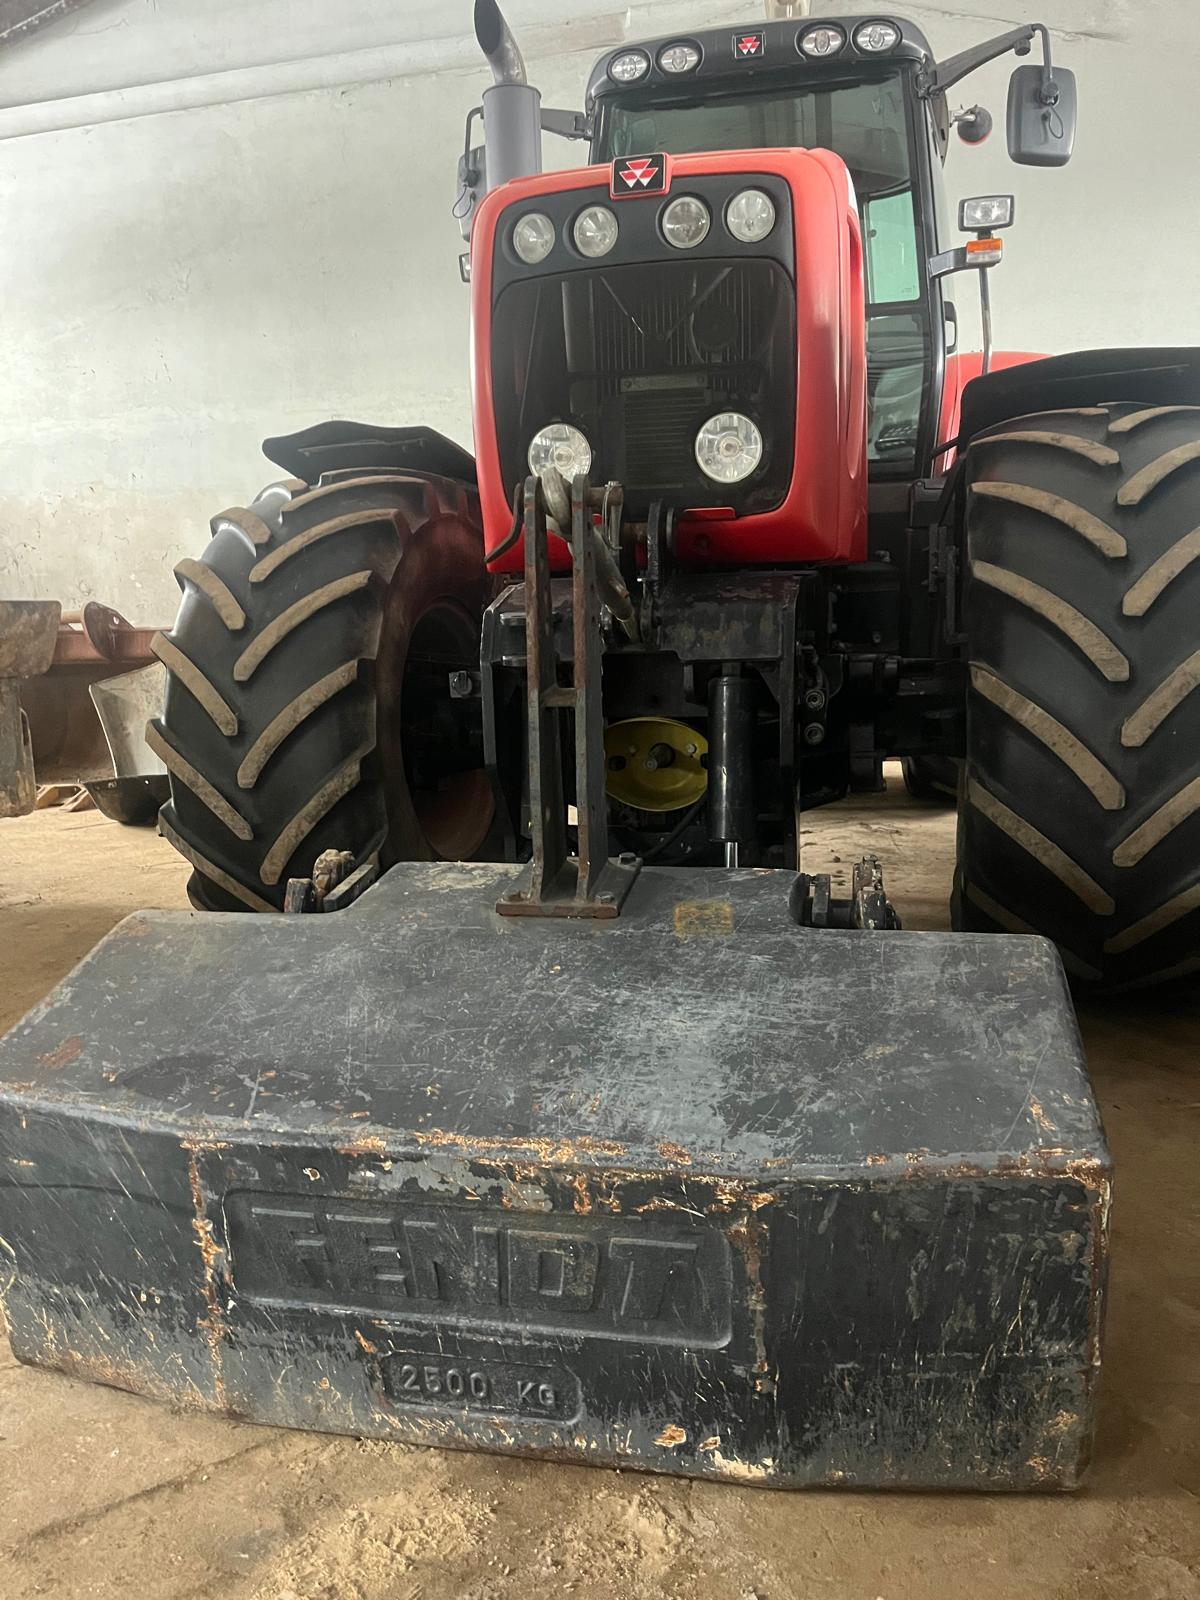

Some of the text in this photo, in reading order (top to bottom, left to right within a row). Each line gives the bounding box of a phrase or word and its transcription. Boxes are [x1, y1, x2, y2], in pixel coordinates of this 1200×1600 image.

[249, 1206, 698, 1319] FENDT
[401, 1364, 556, 1406] 2500 KG
